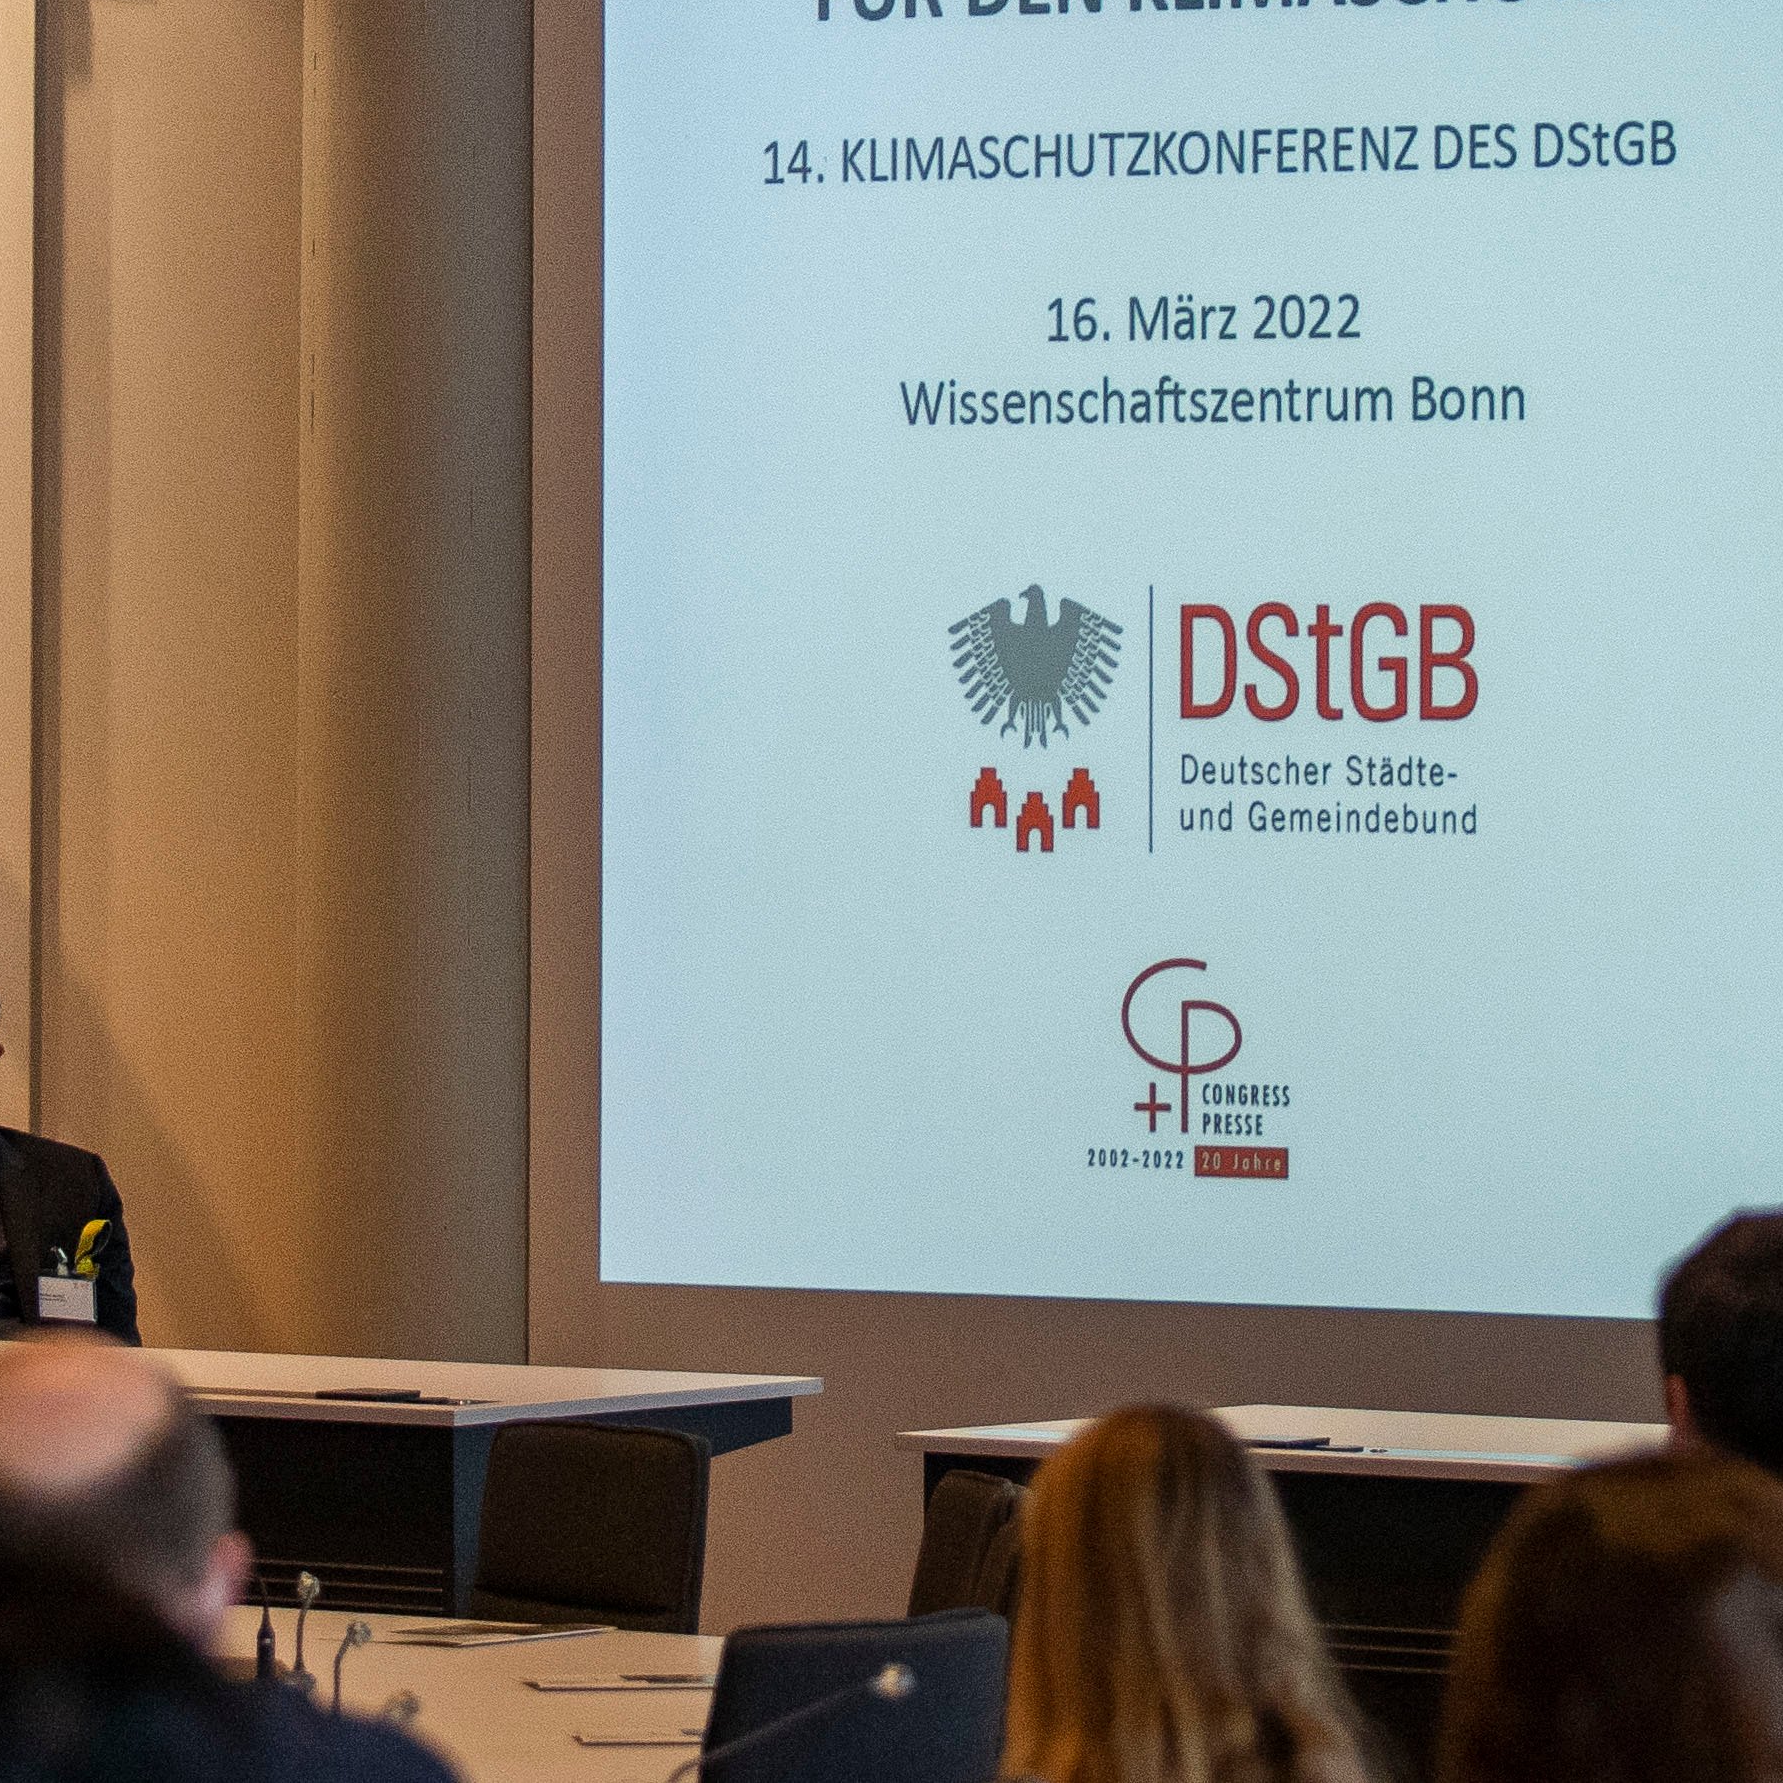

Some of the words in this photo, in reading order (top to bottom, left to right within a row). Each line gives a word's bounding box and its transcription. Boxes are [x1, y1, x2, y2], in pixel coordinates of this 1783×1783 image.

[763, 138, 826, 185] 14.
[841, 124, 1419, 183] KLIMASCHUTZKONFERENZ
[1433, 122, 1518, 172] DES
[1533, 119, 1678, 169] DStGB
[1047, 296, 1112, 343] 16.
[1127, 294, 1238, 341] März
[1252, 293, 1362, 340] 2022
[900, 375, 1394, 427] Wissenschaftszentrum
[1410, 375, 1526, 422] Bonn
[1179, 601, 1479, 723] DStGB
[1180, 753, 1333, 787] Deutscher
[1345, 754, 1458, 788] Städte-
[1179, 802, 1233, 833] und
[1247, 802, 1478, 835] Gemeindebund
[1202, 1083, 1291, 1107] CONGRESS
[1202, 1113, 1263, 1136] PRESSE
[1087, 1148, 1184, 1170] 2002-2022
[1201, 1152, 1222, 1170] 20
[1232, 1153, 1282, 1172] Jahre
